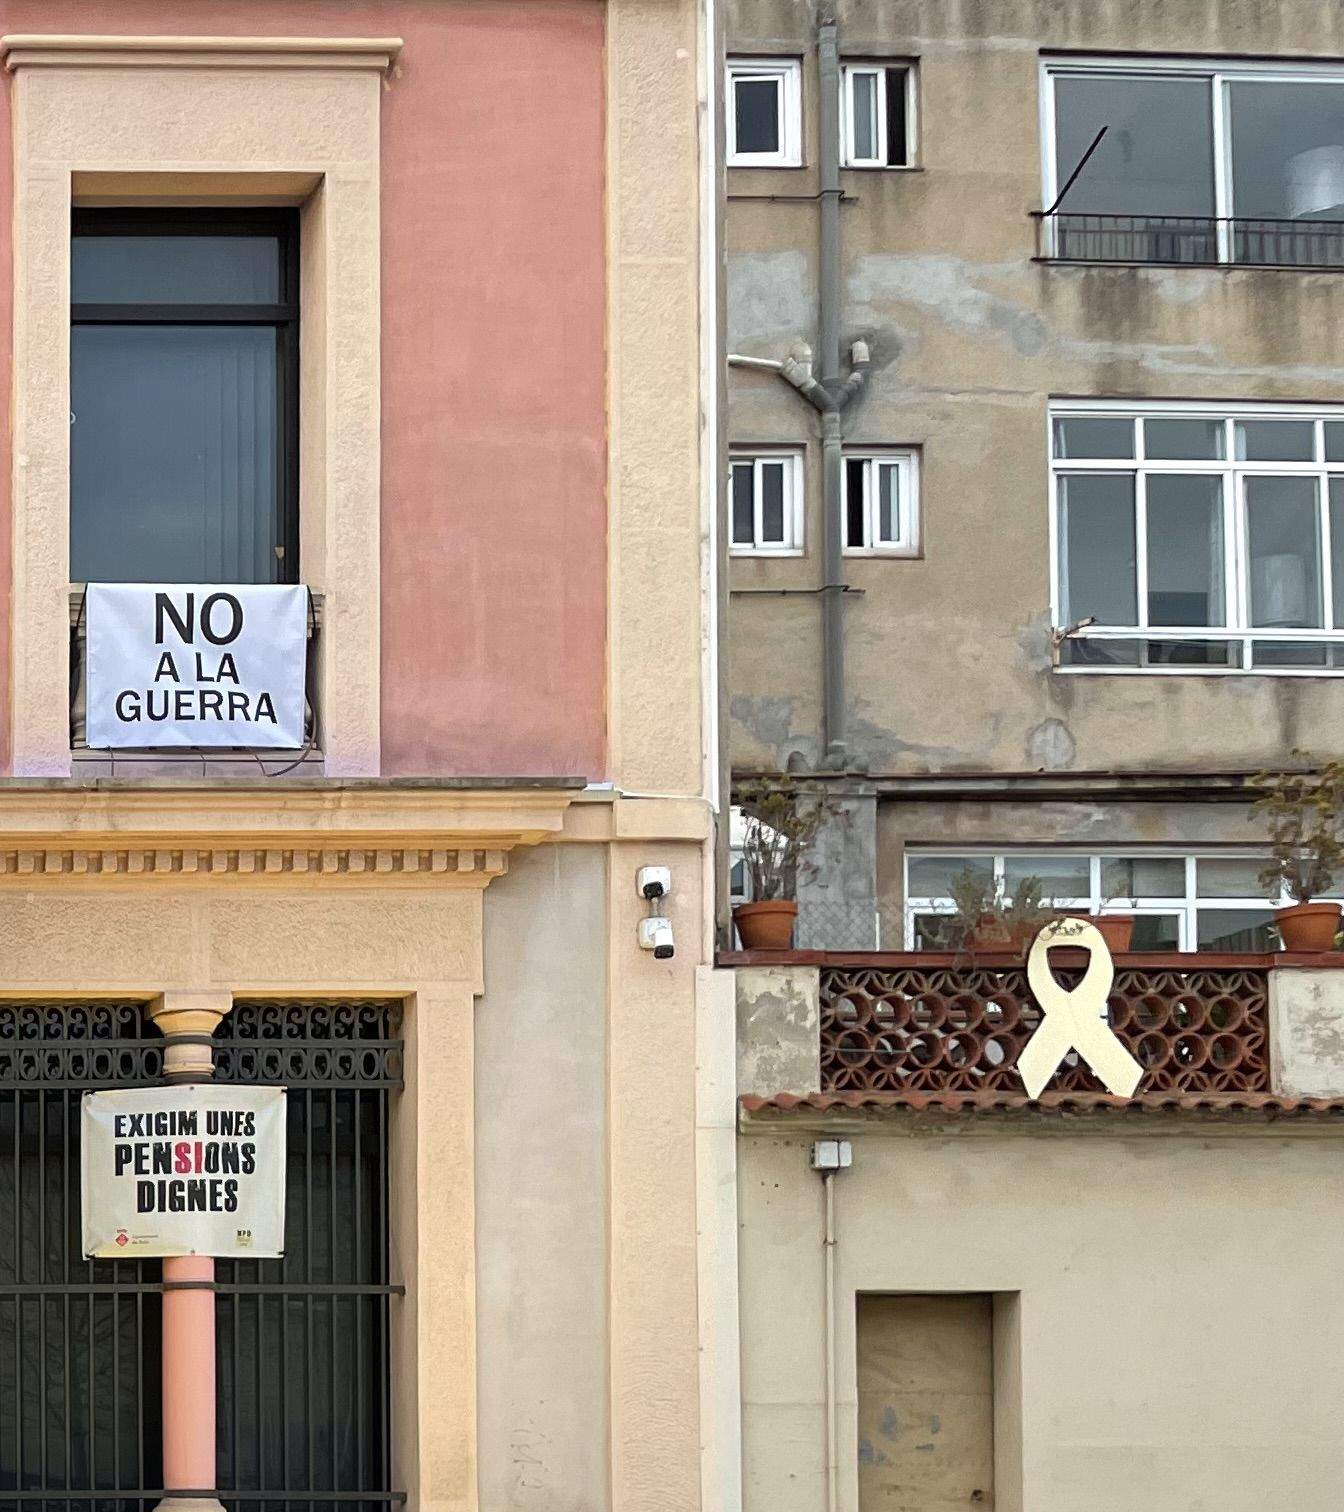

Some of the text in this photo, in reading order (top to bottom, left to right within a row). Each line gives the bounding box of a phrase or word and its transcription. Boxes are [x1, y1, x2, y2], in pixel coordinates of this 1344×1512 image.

[155, 592, 244, 645] NO
[154, 651, 241, 684] A LA
[115, 689, 278, 724] GUERRA
[114, 1110, 256, 1138] EXIGIM UNES
[114, 1141, 256, 1176] PENSIONS
[137, 1178, 239, 1214] DIGNES
